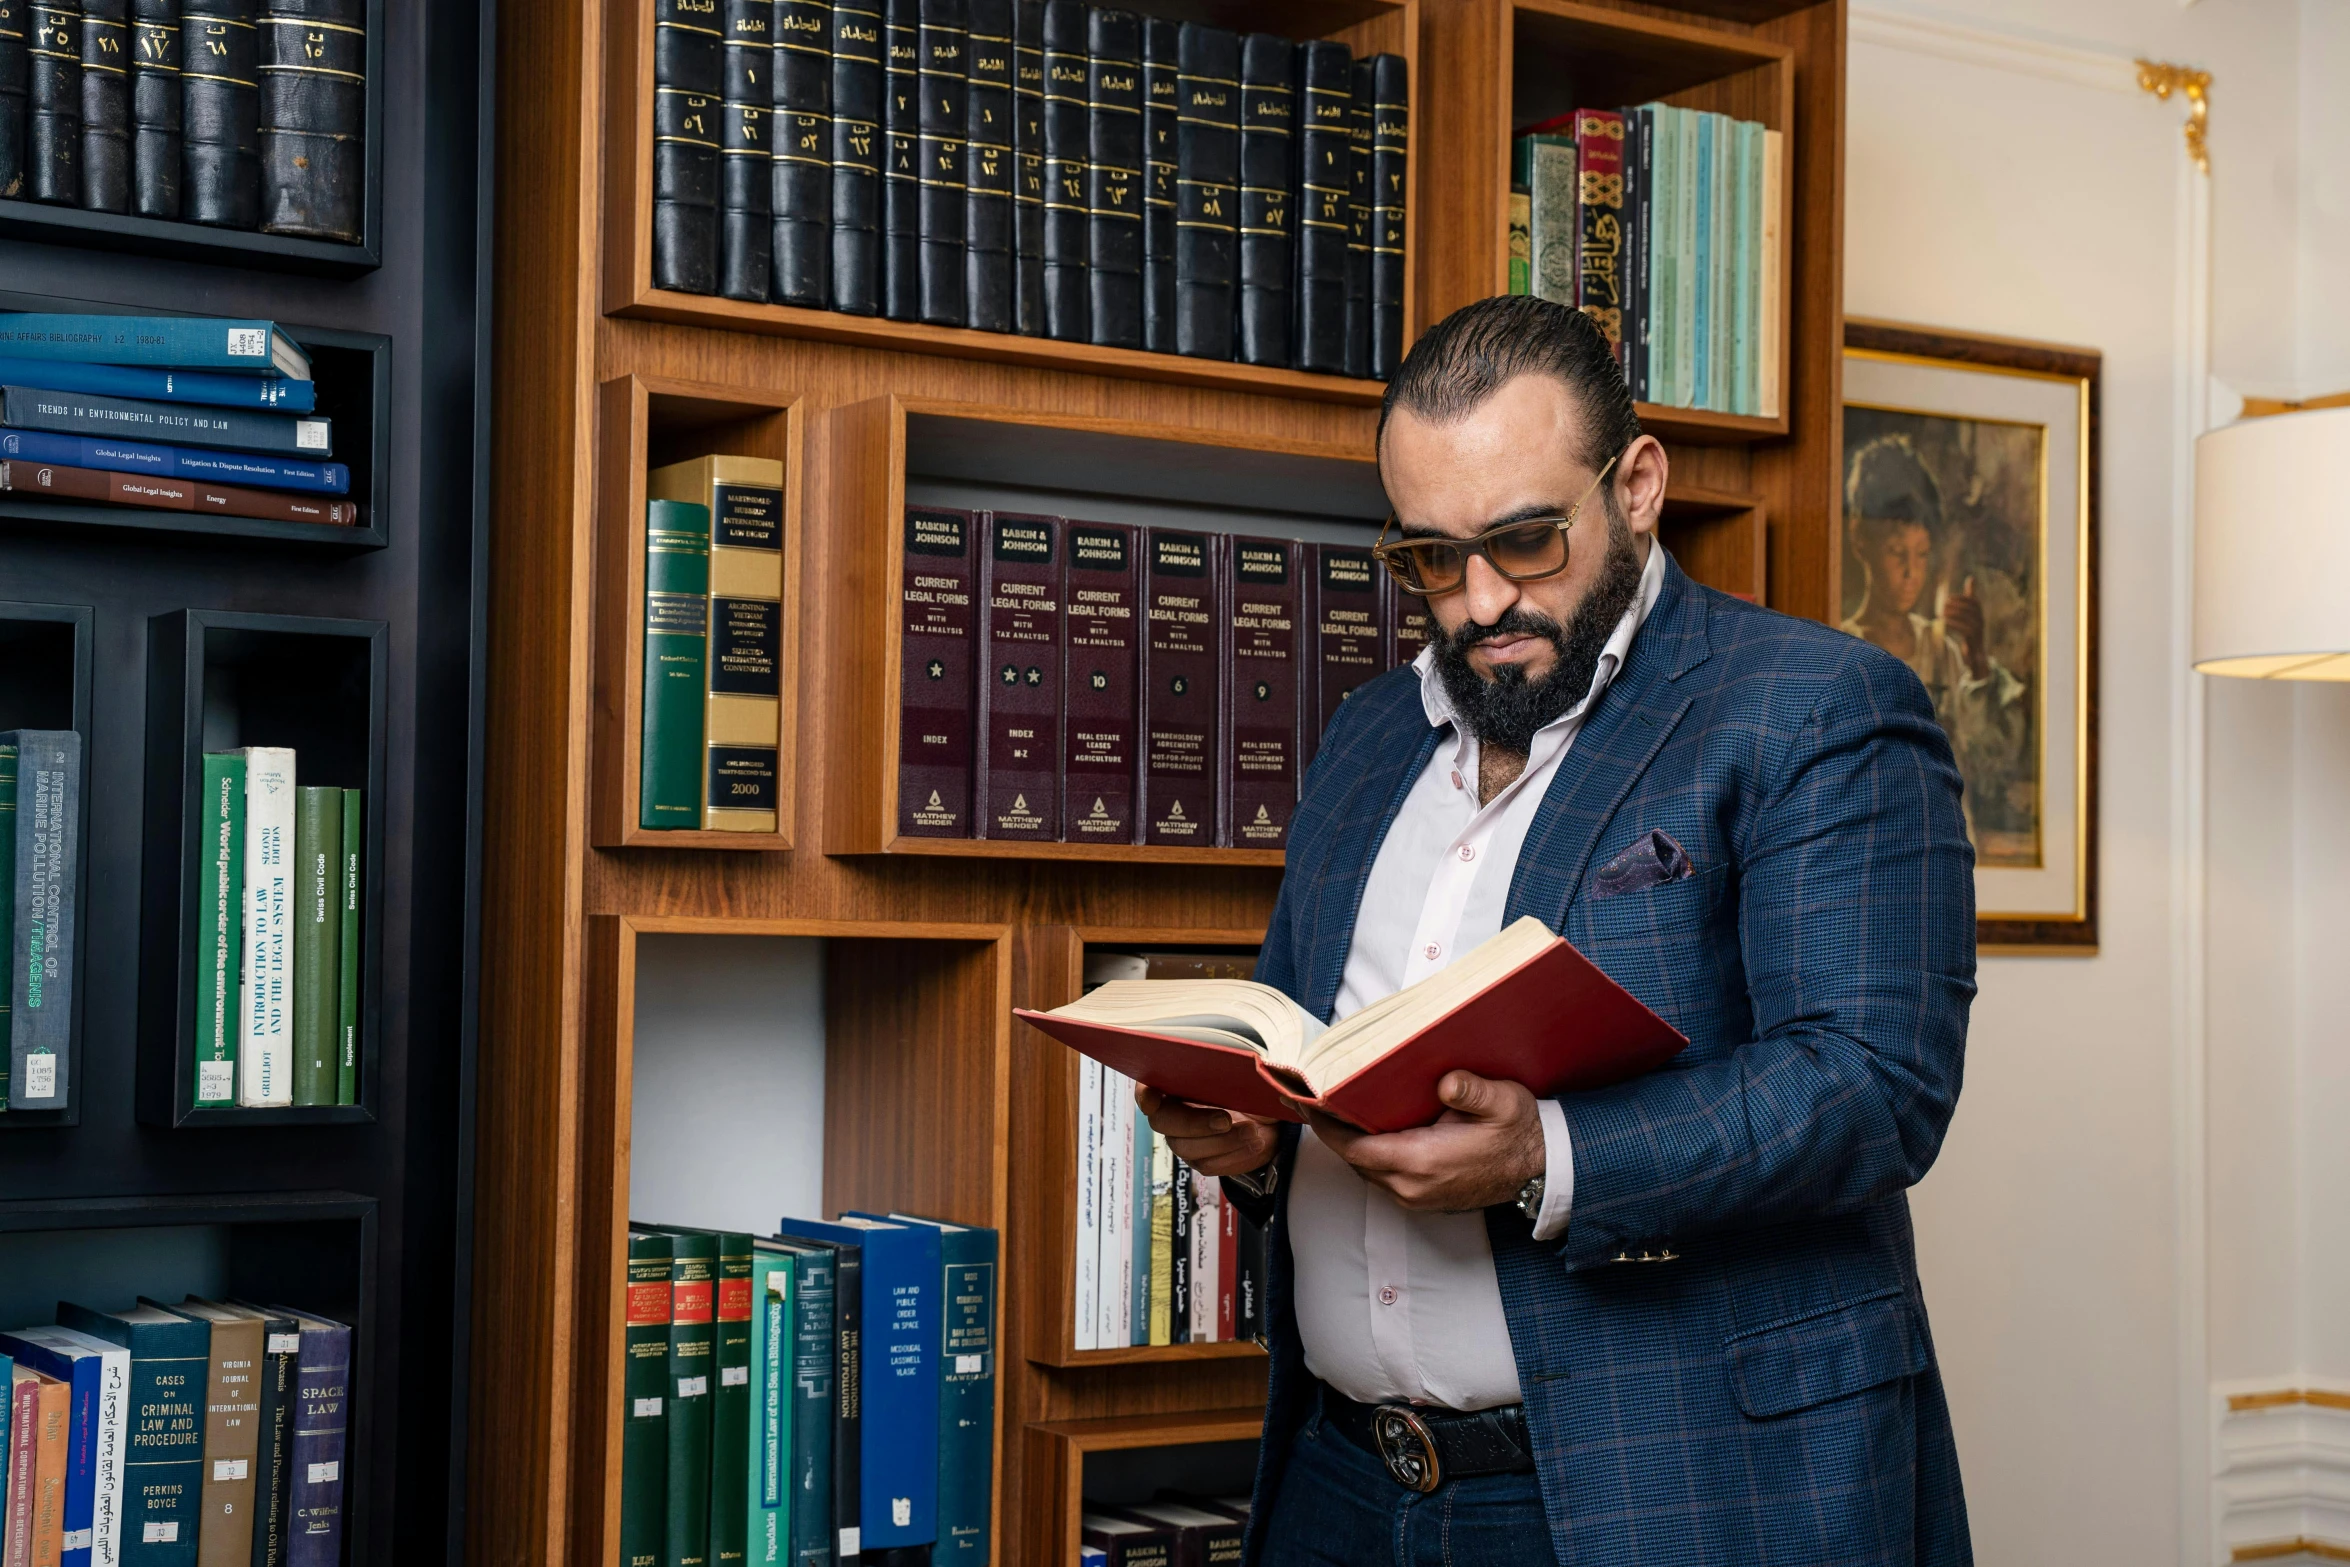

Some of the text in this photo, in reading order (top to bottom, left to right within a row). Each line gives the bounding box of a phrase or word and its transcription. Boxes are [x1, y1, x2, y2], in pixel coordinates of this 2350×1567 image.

[38, 26, 68, 45] ٣٥
[98, 37, 119, 53] ٢٨
[141, 37, 170, 59] ١٧
[684, 115, 704, 134] ٥٦
[742, 126, 758, 140] ١٦
[1203, 202, 1221, 217] ٥٨
[1266, 209, 1284, 226] ٥٧
[38, 404, 228, 430] TRENDS IN ENVIRONMENTAL POLICY AND LAW
[95, 449, 161, 463] Global Legal Insights
[182, 458, 211, 468] Litigation
[218, 462, 243, 472] Dispute
[243, 464, 275, 474] Resolution
[122, 484, 183, 499] Global Legal Insights
[206, 494, 227, 504] Energy
[723, 517, 775, 529] INTERNATIONAL
[915, 533, 960, 546] JOHNSON
[1002, 540, 1047, 553] JOHNSON
[1077, 549, 1121, 560] JOHNSON
[1159, 554, 1201, 567] JOHNSON
[1242, 562, 1282, 574] JOHNSON
[1329, 570, 1370, 582] JOHNSON
[915, 576, 959, 589] CURRENT
[1001, 583, 1045, 596] CURRENT
[905, 590, 969, 605] LEGAL FORMS
[1077, 590, 1120, 603] CURRENT
[1158, 595, 1199, 609] CURRENT
[991, 597, 1056, 612] LEGAL FORMS
[1242, 603, 1281, 615] CURRENT
[733, 612, 763, 620] VIETNAM
[1068, 605, 1130, 618] LEGAL FORMS
[1149, 609, 1209, 624] LEGAL FORMS
[1329, 610, 1369, 623] CURRENT
[910, 624, 963, 635] TAX ANALYSIS
[1234, 617, 1291, 630] LEGAL FORMS
[996, 630, 1050, 641] TAX ANALYSIS
[1321, 623, 1378, 637] LEGAL FORMS
[721, 655, 773, 666] INTERNATIONAL
[723, 664, 771, 674] CONVENTIONS
[1093, 676, 1105, 688] 10
[923, 735, 947, 744] INDEX
[1009, 729, 1034, 739] INDEX
[1096, 733, 1120, 742] ESTATE
[1087, 742, 1111, 750] LEASES
[1156, 740, 1199, 749] AGREEMENTS
[1075, 754, 1122, 763] AGRICULTURE
[1152, 762, 1202, 771] CORPORATIONS
[1242, 762, 1282, 771] SUBDIVISION
[731, 783, 760, 795] 2000
[913, 812, 956, 821] MATTHEW
[998, 816, 1042, 824] MATTHEW
[1077, 820, 1121, 828] MATTHEW
[1156, 821, 1198, 829] MATTHEW
[1242, 825, 1282, 833] MATTHEW
[262, 827, 270, 864] SECOND
[272, 826, 280, 865] EDITION
[44, 752, 65, 978] 2 INTERNATIONAL CONTROL OF
[316, 853, 325, 923] Swiss Civil Code
[215, 777, 232, 1048] Schneider World public order of the environment
[254, 886, 268, 1036] INTRODUCTION TO LAW
[270, 877, 284, 1036] AND THE LEGAL SYSTEM
[262, 1050, 272, 1097] GRILLIOT
[893, 1286, 920, 1295] LAW AND
[896, 1298, 917, 1306] PUBLIC
[897, 1310, 916, 1318] ORDER
[890, 1344, 921, 1353] MCDOUGAL
[222, 1360, 251, 1369] VIRGINIA
[891, 1356, 921, 1365] LASSWELL
[221, 1375, 249, 1383] JOURNAL
[278, 1354, 288, 1392] Abecassis
[841, 1330, 850, 1418] LAW OF POLLUTION
[850, 1330, 859, 1418] THE INTERNATIONAL
[156, 1375, 185, 1386] CASES
[231, 1390, 239, 1398] OF
[302, 1386, 344, 1399] SPACE
[141, 1403, 194, 1417] CRIMINAL
[209, 1403, 258, 1413] INTERNATIONAL
[307, 1403, 339, 1415] LAW
[141, 1418, 193, 1431] LAW AND
[226, 1419, 241, 1427] LAW
[134, 1432, 198, 1447] PROCEDURE
[98, 1366, 121, 1564] شرح الأحكام العامة لقانون العقوبات الليبي
[14, 1394, 31, 1559] MULTINATIONAL CORPORATIONS AND DEVELOPING
[143, 1485, 183, 1496] PERKINS
[147, 1498, 177, 1509] BOYCE
[224, 1503, 233, 1514] 8
[298, 1506, 338, 1517] C. Wilfred
[307, 1521, 330, 1531] Jenks
